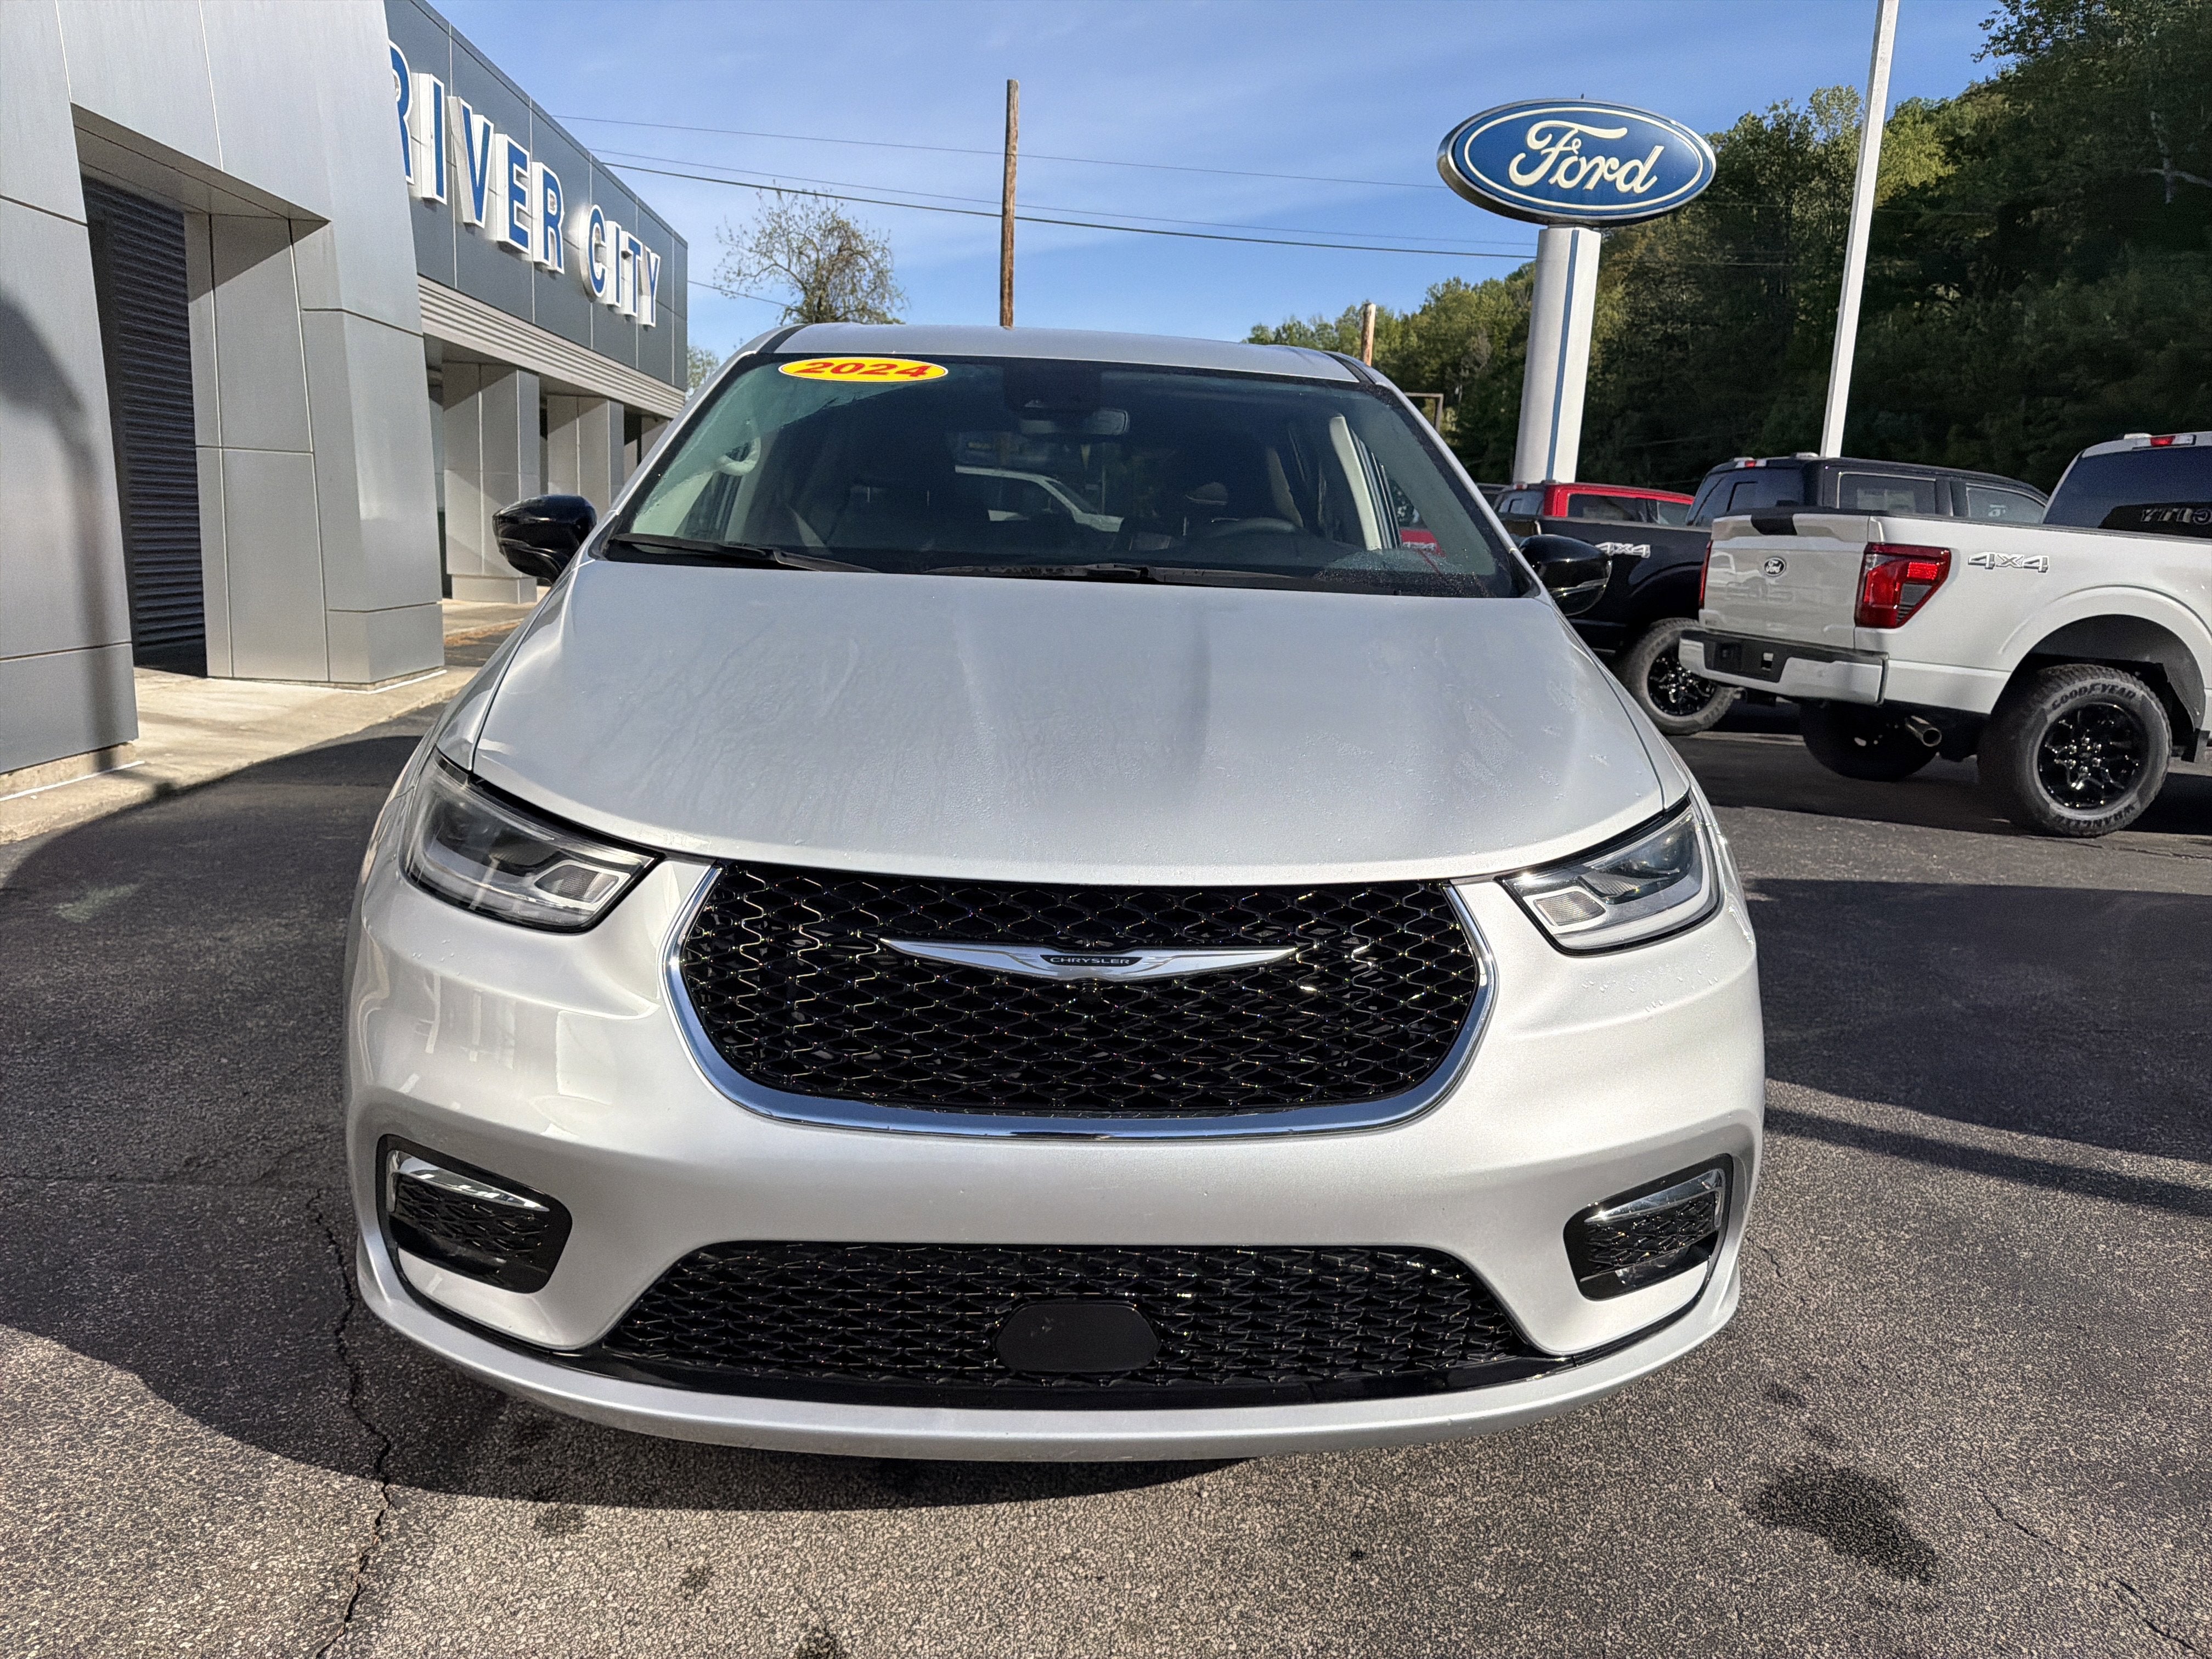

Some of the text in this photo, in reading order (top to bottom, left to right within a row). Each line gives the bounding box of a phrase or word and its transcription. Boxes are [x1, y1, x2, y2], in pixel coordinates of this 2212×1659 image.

[1509, 120, 1664, 193] Ford
[580, 205, 660, 326] CITY
[793, 362, 932, 377] 2024
[2052, 682, 2136, 710] GOODYEAR
